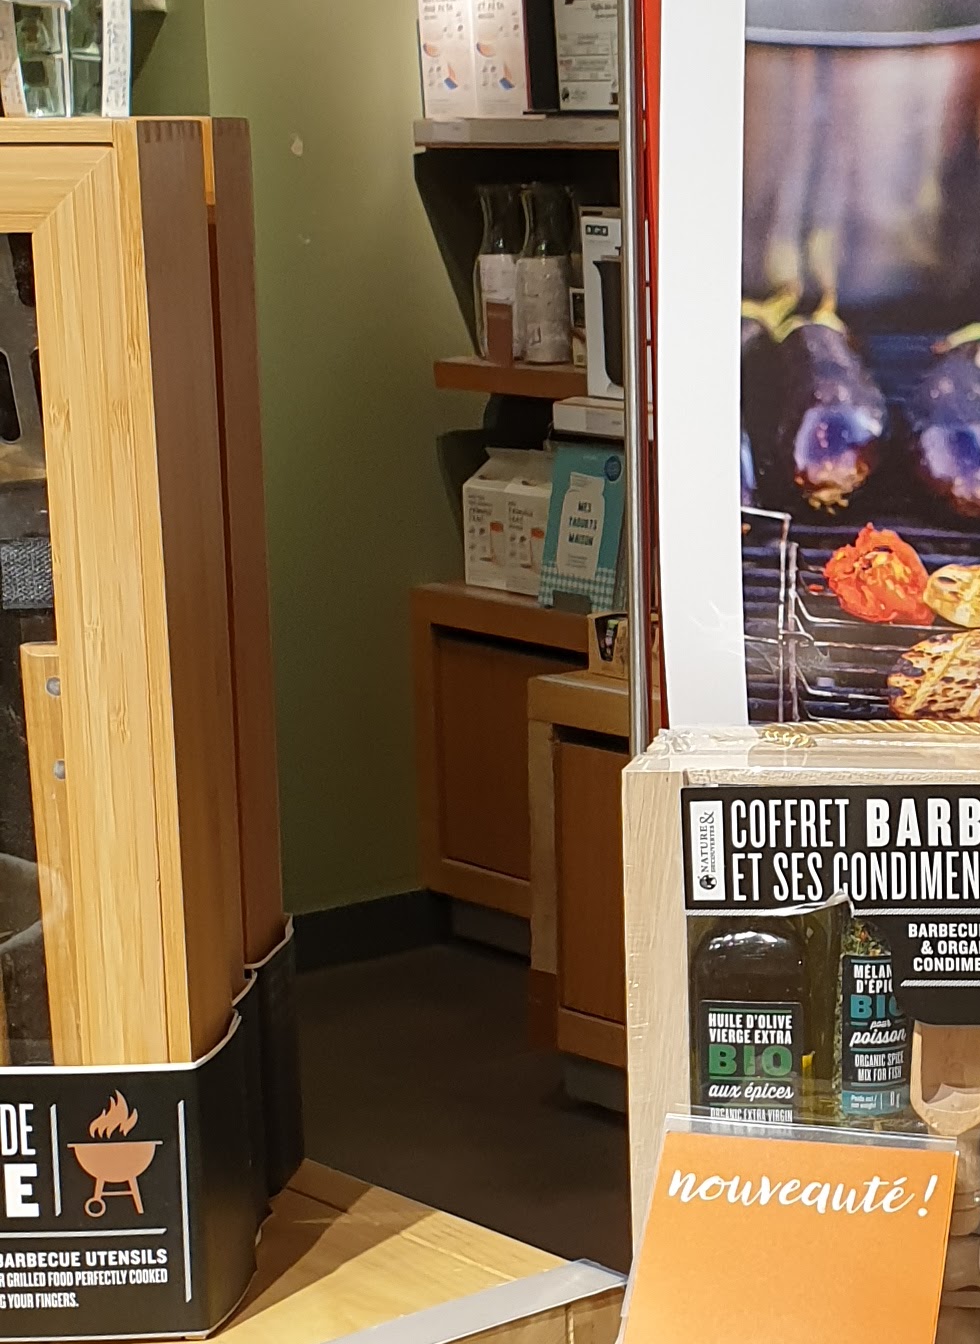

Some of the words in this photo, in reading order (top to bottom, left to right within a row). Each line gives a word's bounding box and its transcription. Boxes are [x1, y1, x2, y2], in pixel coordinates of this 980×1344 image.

[578, 501, 592, 513] MES
[569, 516, 598, 530] YAOURTS
[569, 532, 593, 546] MAISON
[731, 799, 849, 848] COFFRET
[732, 853, 762, 901] ET
[773, 852, 823, 901] SES
[709, 1013, 743, 1028] HUILE
[747, 1014, 792, 1029] D'OLIVE
[709, 1028, 751, 1043] VIERGE
[755, 1030, 792, 1044] EXTRA
[850, 1028, 906, 1047] poisson
[709, 1044, 792, 1076] BIO
[709, 1085, 741, 1098] aux
[745, 1082, 794, 1101] épices
[668, 1170, 915, 1214] nouveauté
[918, 1175, 938, 1217] !
[86, 1249, 167, 1267] UTENSILS
[7, 1271, 46, 1287] GRILLED
[48, 1271, 72, 1287] FOOD
[75, 1269, 127, 1286] PERFECTLY
[129, 1268, 167, 1284] COOKED
[8, 1293, 33, 1308] YOUR
[36, 1292, 79, 1308] FINGERS.
